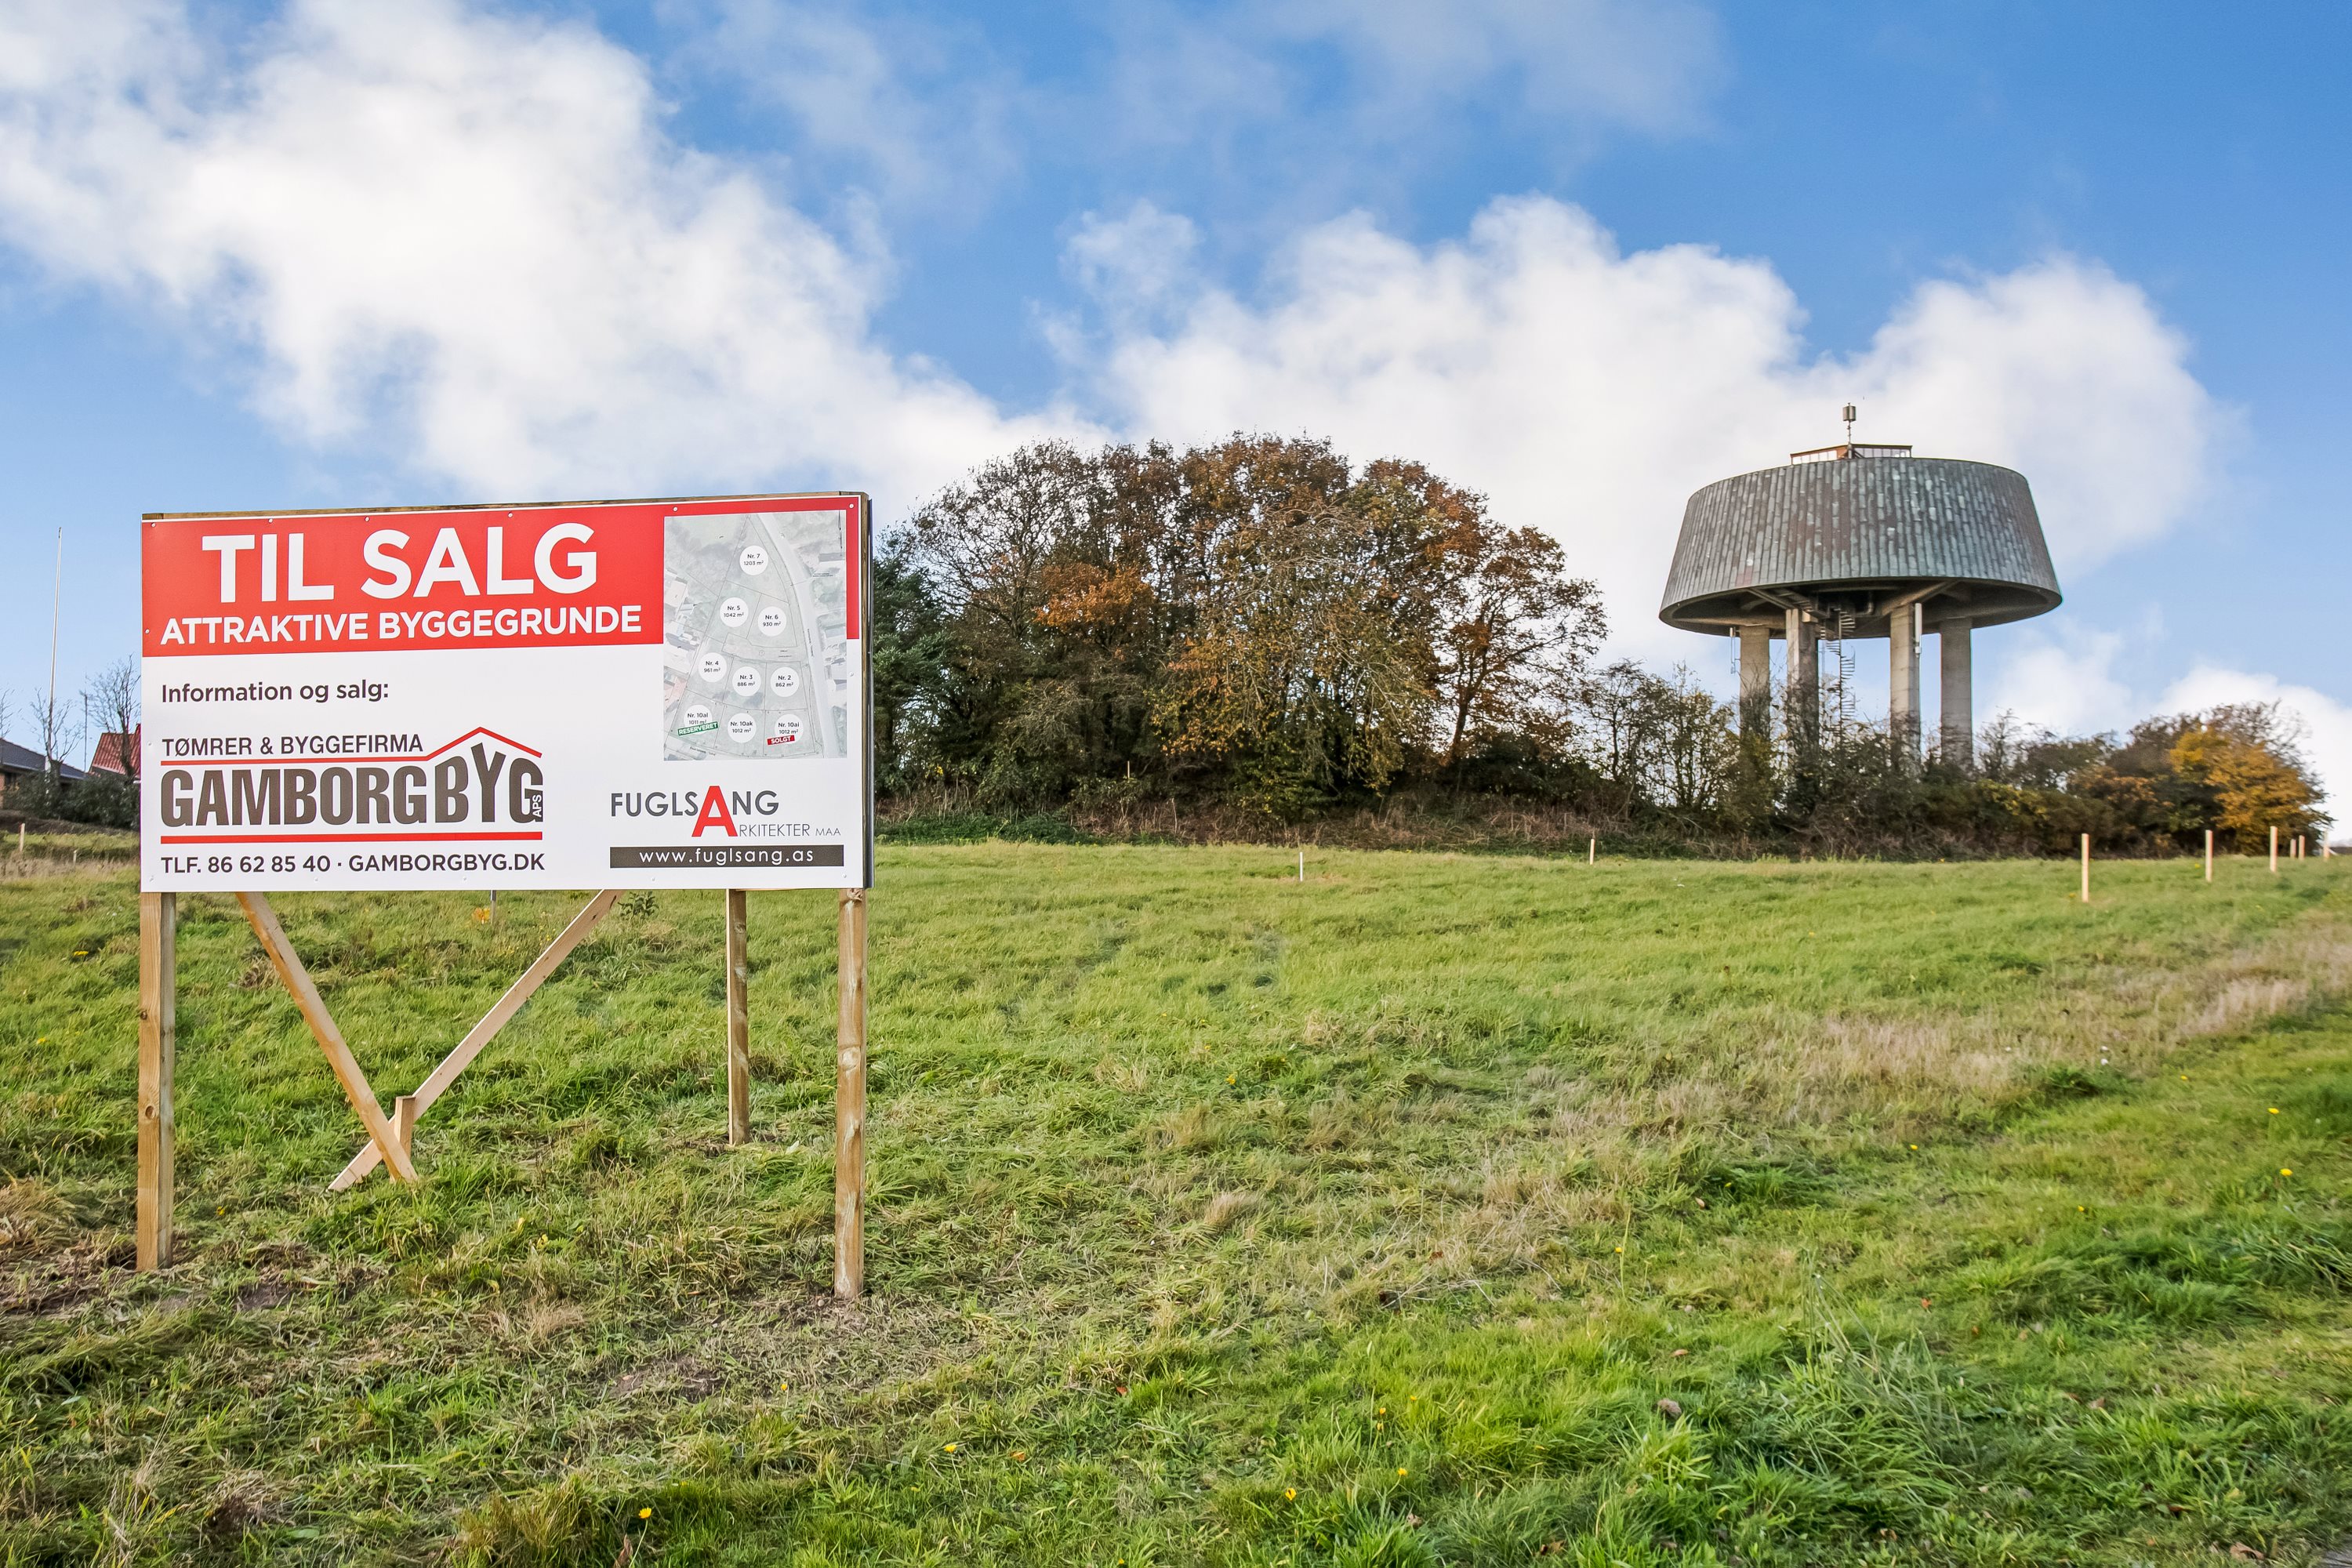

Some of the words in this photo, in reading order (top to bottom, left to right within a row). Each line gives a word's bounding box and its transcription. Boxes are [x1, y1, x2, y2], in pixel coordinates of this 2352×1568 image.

[201, 532, 335, 604] TIL
[360, 522, 597, 600] SALG
[160, 612, 368, 645] ATTRAKTIVE
[379, 604, 642, 641] BYGGEGRUNDE
[162, 682, 292, 703] Information
[299, 684, 328, 702] og
[336, 679, 390, 702] salg:
[678, 722, 717, 735] RESERVERET
[162, 737, 252, 757] TØMRER
[260, 737, 274, 755] &
[281, 734, 424, 755] BYGGEFIRMA
[532, 793, 543, 818] APS
[815, 827, 841, 837] MAA
[161, 856, 201, 873] TLF.
[208, 856, 233, 873] 86
[240, 855, 265, 873] 62
[271, 855, 296, 873] 85
[303, 855, 331, 872] 40
[349, 853, 546, 872] GAMBORGBYG.DK
[639, 848, 814, 866] www.fuglsang.as
